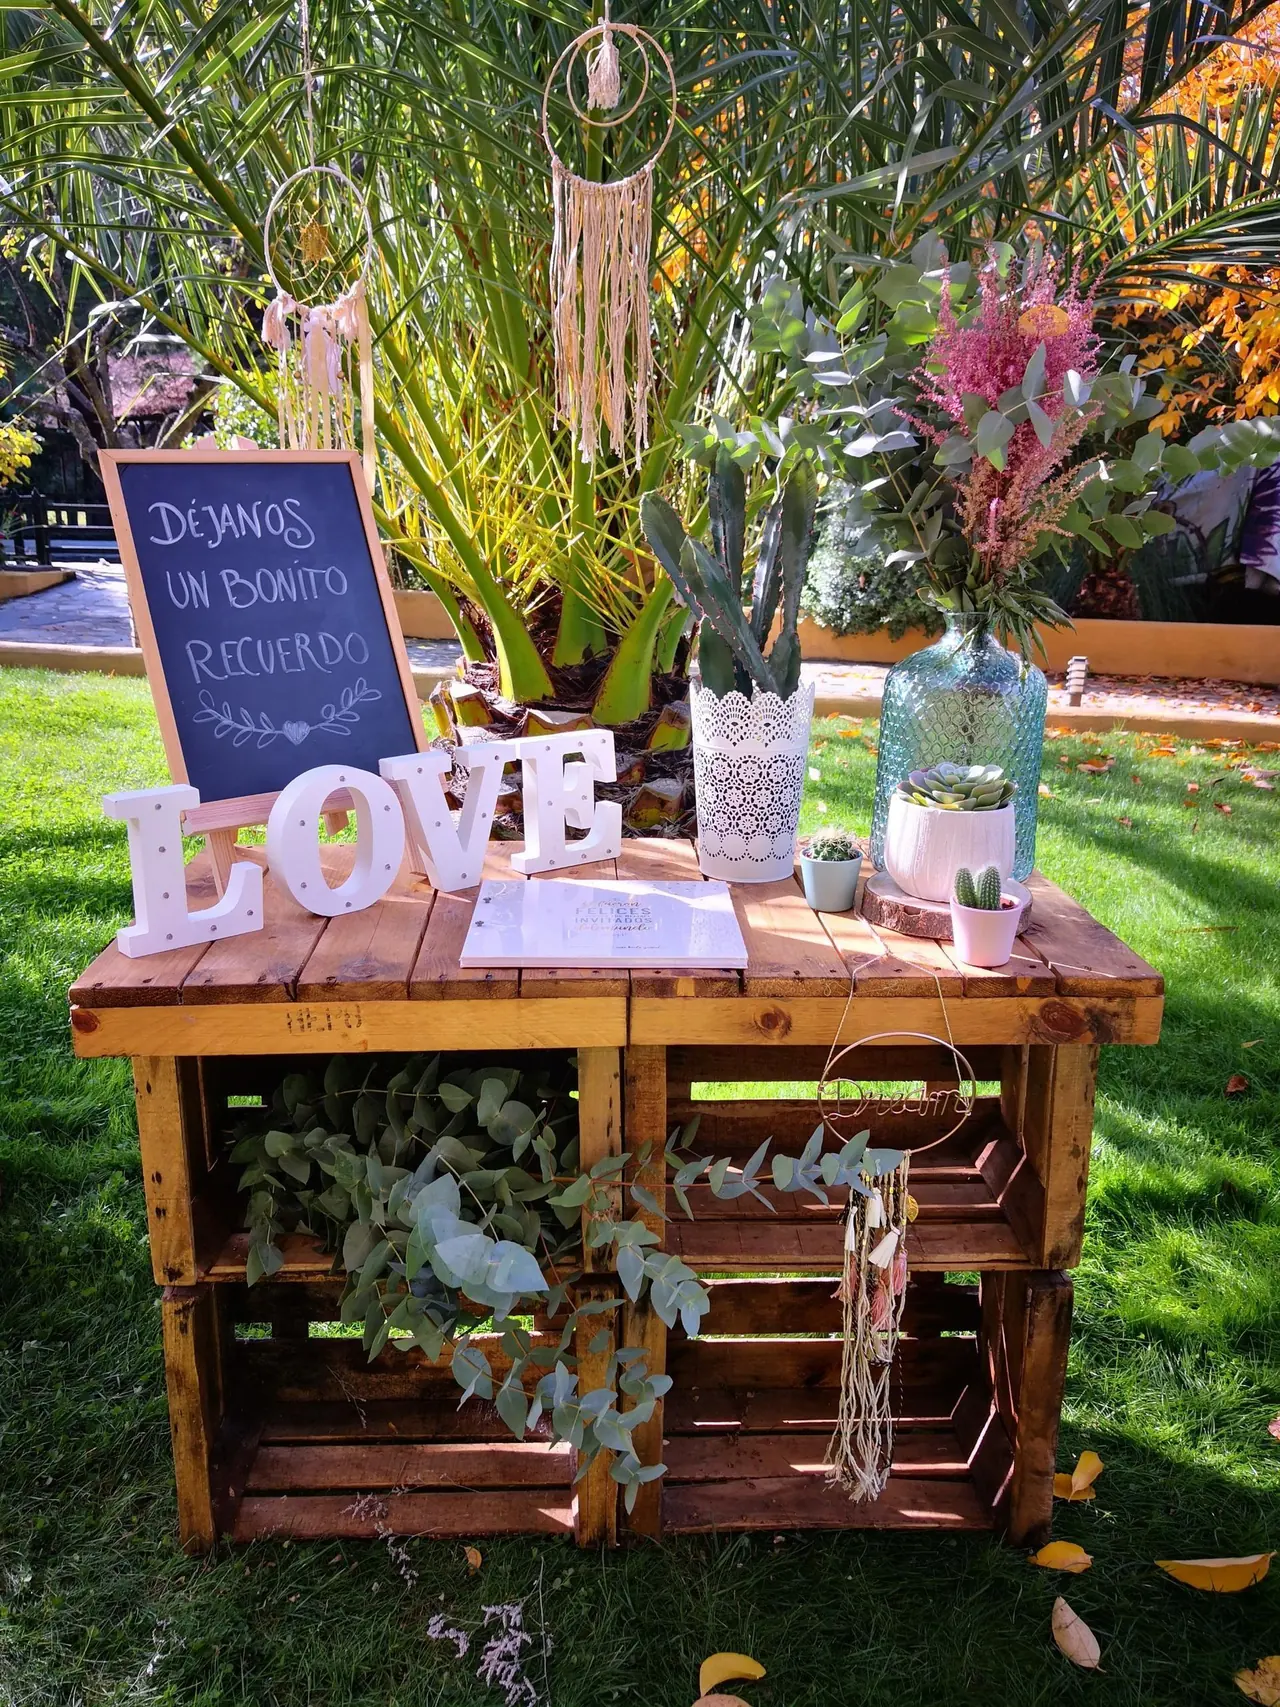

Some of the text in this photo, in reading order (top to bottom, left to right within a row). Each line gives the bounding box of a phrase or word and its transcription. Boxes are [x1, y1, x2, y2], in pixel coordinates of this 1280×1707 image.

[148, 498, 315, 549] DÉJANOS
[166, 570, 210, 609] UN
[185, 632, 370, 684] RECUERDO
[102, 729, 622, 959] LOVE
[575, 907, 652, 915] FELICES
[821, 1077, 972, 1120] Dream
